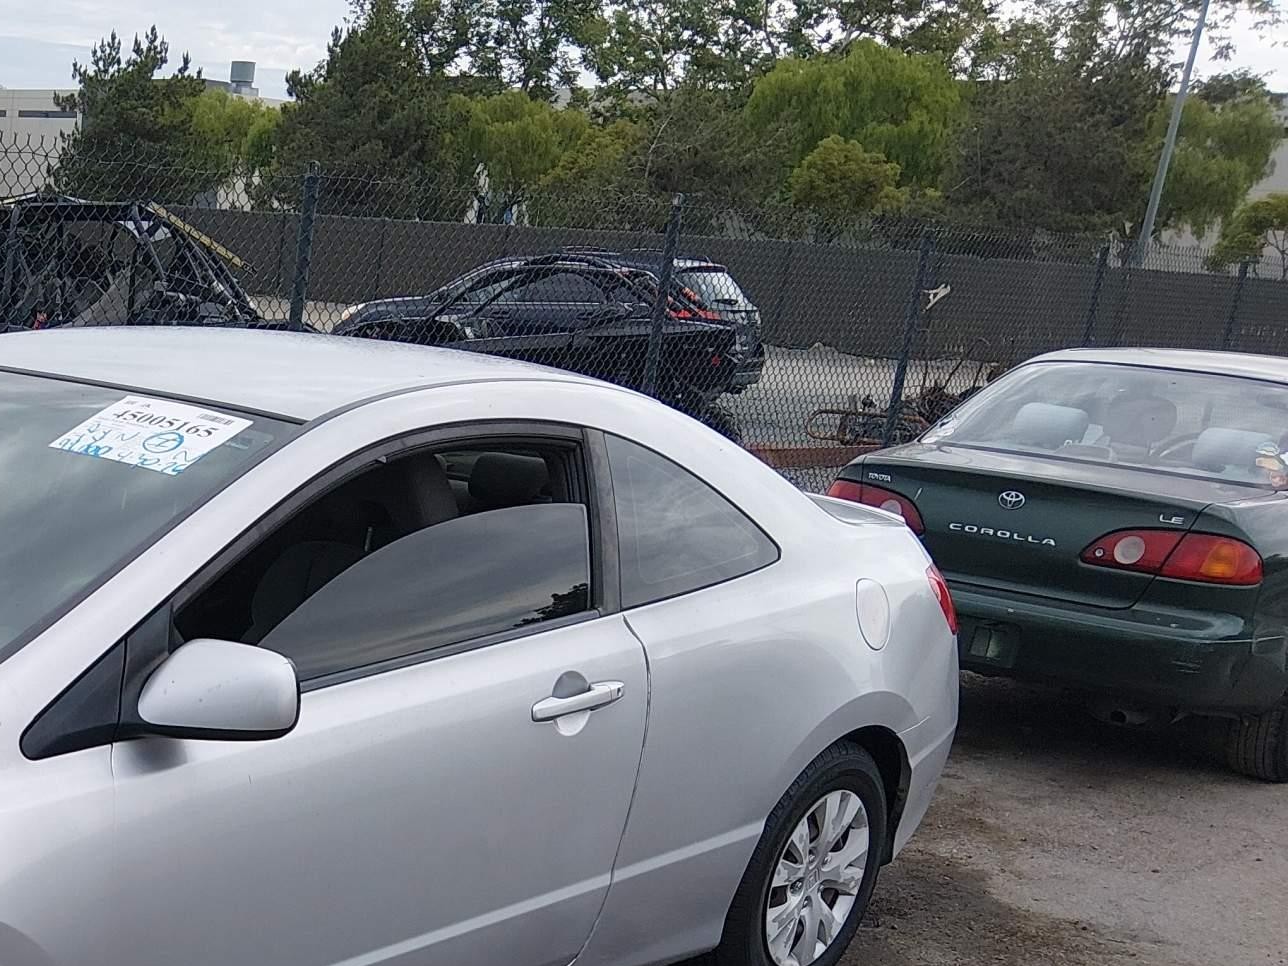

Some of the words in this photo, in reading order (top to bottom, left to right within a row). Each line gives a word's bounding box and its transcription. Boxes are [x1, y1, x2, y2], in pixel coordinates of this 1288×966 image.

[112, 409, 220, 438] 45005165
[868, 472, 892, 483] TOYOTA
[1159, 514, 1185, 525] LE
[949, 523, 1056, 546] COROLLA
